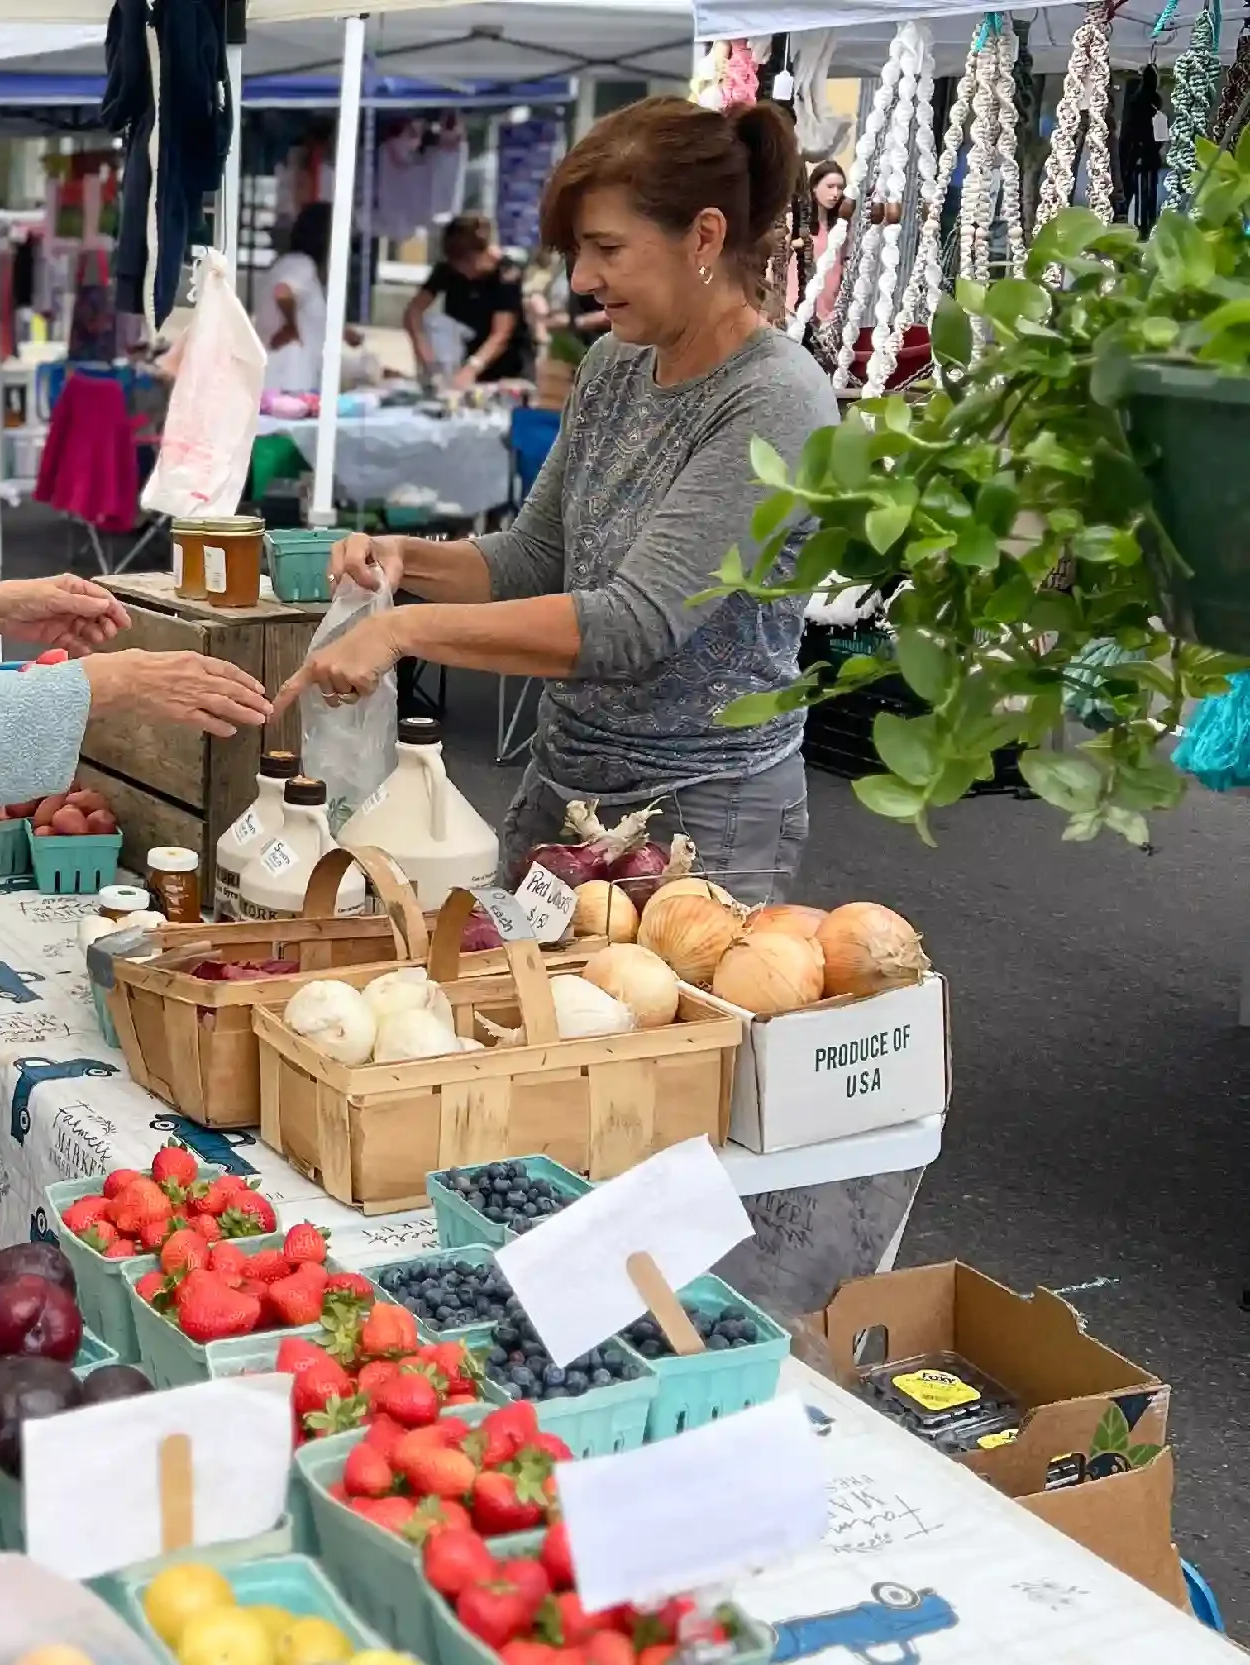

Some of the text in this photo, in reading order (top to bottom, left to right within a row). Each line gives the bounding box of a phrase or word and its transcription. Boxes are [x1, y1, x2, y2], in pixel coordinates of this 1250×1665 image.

[526, 870, 551, 898] Red
[815, 1023, 911, 1073] PRODUCE OF
[846, 1067, 882, 1099] USA
